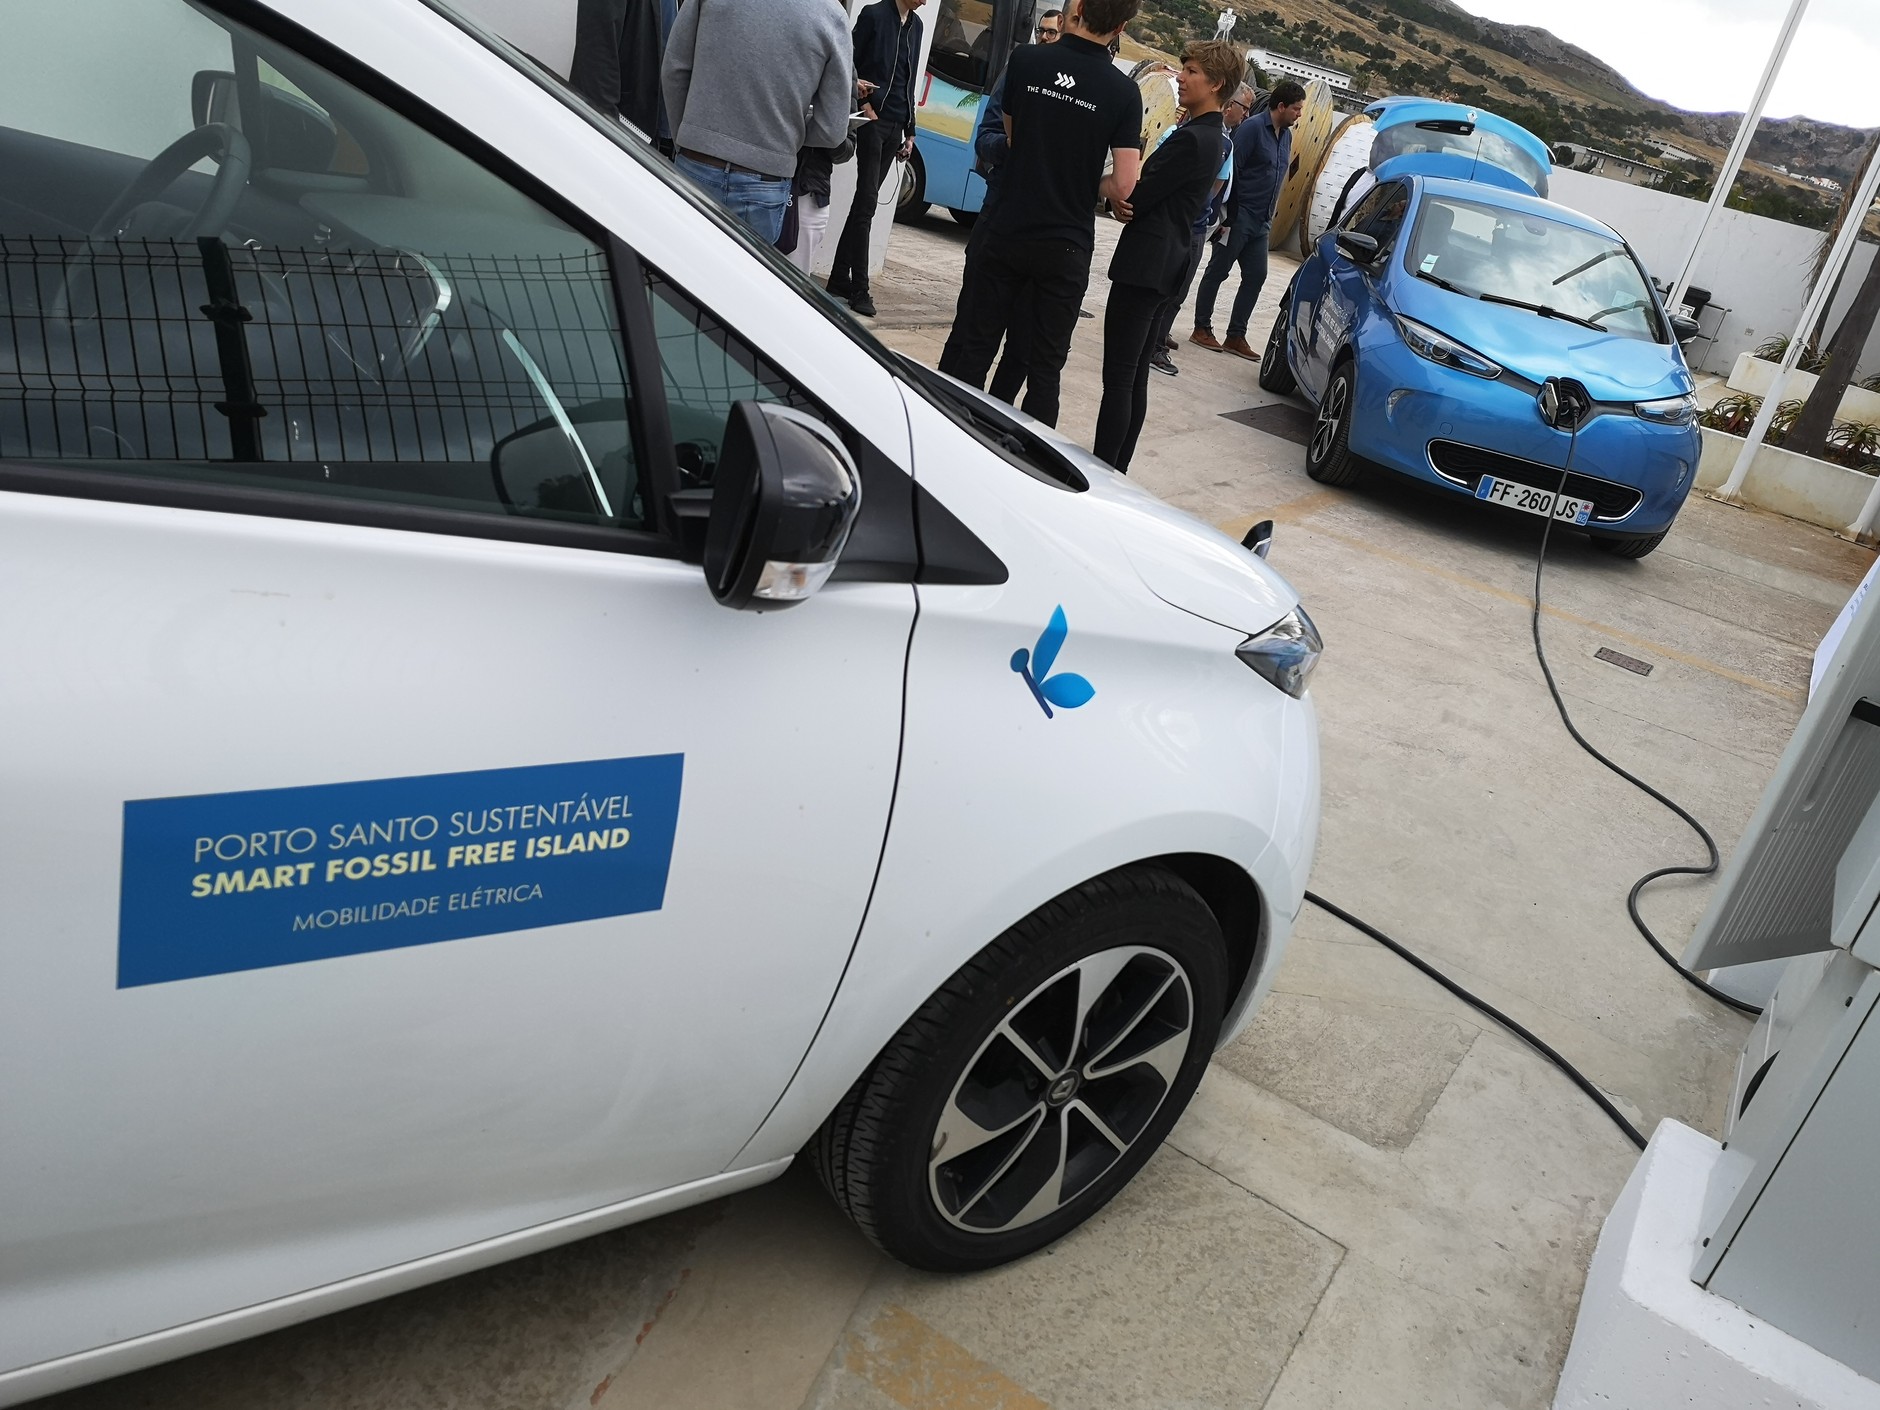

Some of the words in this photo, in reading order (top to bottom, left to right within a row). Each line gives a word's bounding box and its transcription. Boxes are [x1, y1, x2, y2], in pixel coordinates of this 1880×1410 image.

[1026, 85, 1040, 94] THE
[1041, 88, 1074, 103] MOBILITY
[1075, 98, 1097, 112] HOUSE
[1489, 481, 1579, 519] FF-260JS
[1577, 513, 1587, 523] 92
[194, 827, 318, 863] PORTO
[328, 815, 439, 850] SANTO
[448, 792, 633, 837] SUSTENTÁVEL
[191, 862, 315, 898] SMART
[325, 849, 437, 882] FOSSIL
[447, 840, 517, 868] FREE
[525, 827, 631, 859] ISLAND
[292, 895, 440, 932] MOBILIDADE
[448, 883, 544, 912] ELÉTRICA
